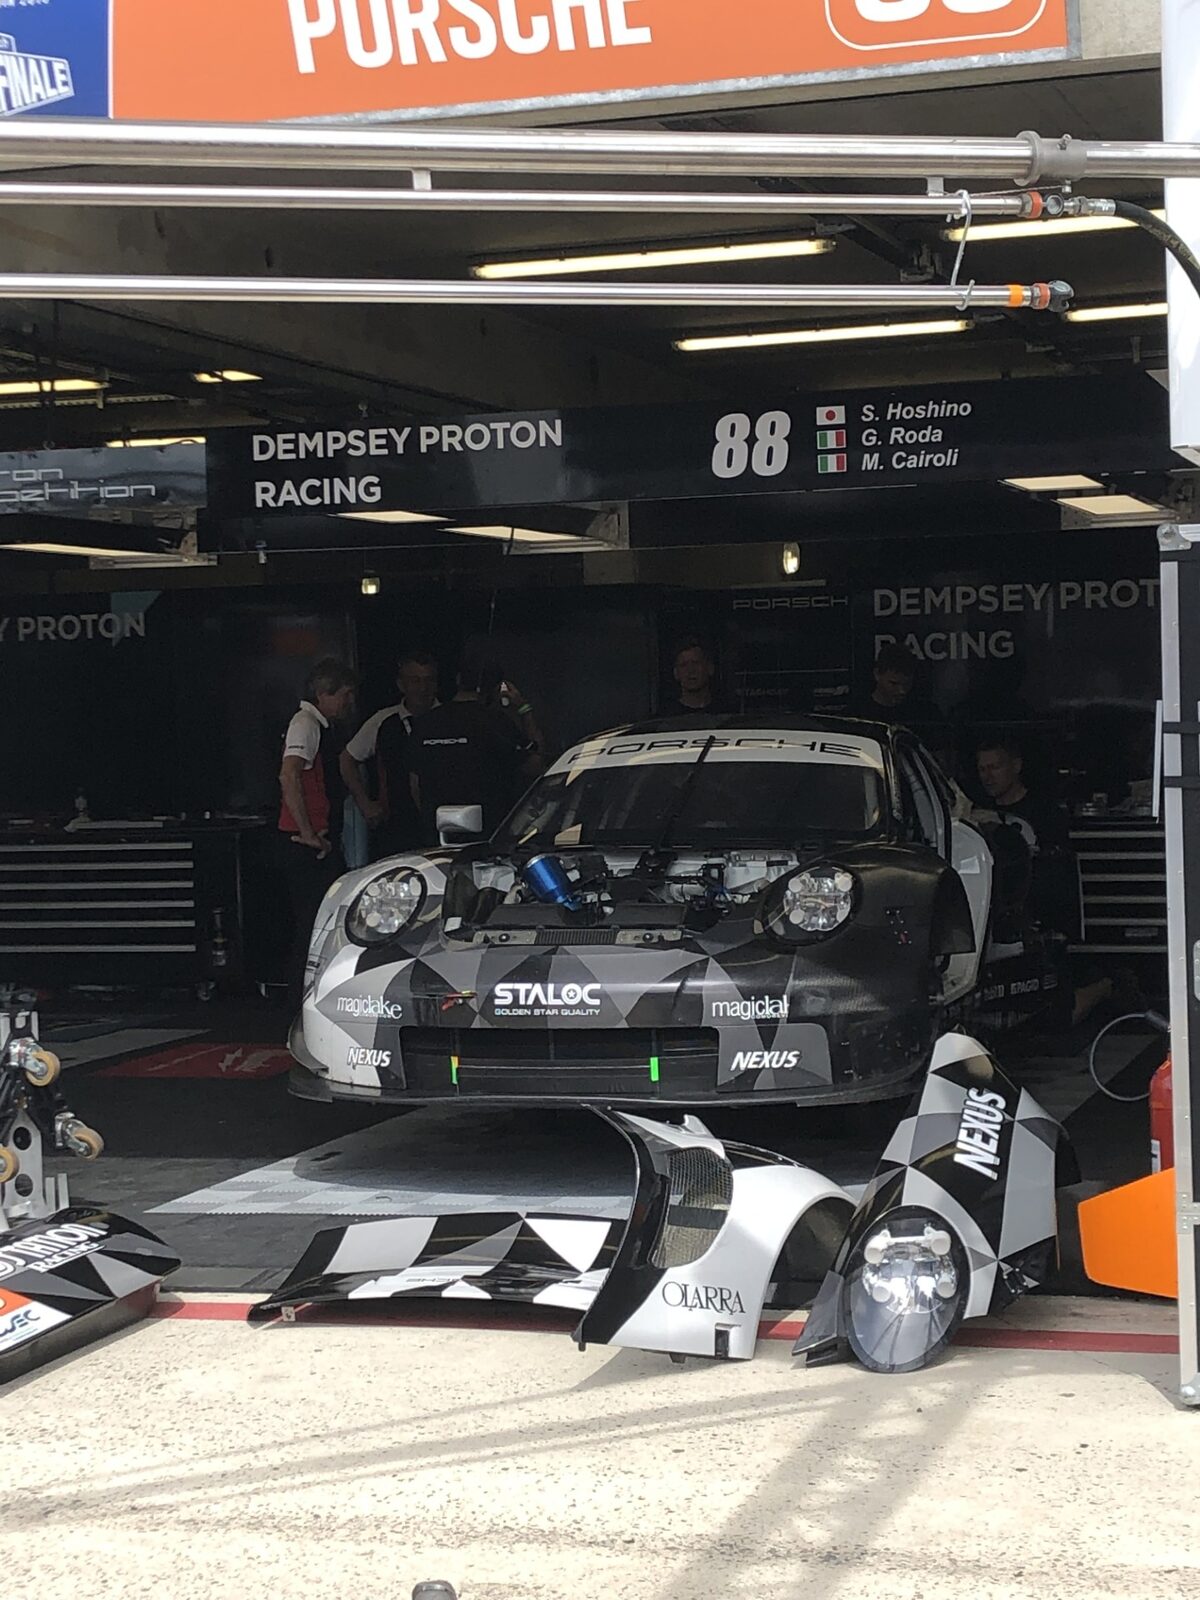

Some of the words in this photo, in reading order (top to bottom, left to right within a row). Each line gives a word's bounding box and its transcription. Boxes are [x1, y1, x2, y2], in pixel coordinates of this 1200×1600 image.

[861, 404, 880, 422] S.
[886, 400, 972, 421] Hoshino
[252, 427, 411, 461] DEMPSEY
[420, 419, 563, 453] PROTON
[711, 410, 792, 479] 88
[861, 428, 882, 446] G.
[889, 426, 943, 445] Roda
[861, 453, 884, 471] M.
[891, 449, 959, 470] Cairoli
[255, 475, 382, 508] RACING
[873, 583, 1051, 617] DEMPSEY
[17, 612, 146, 642] PROTON
[567, 738, 861, 764] PORSCHE
[336, 995, 402, 1019] magiclake
[494, 983, 601, 1005] STALOC
[494, 1008, 531, 1016] GOLDEN
[533, 1008, 558, 1016] STAR
[560, 1008, 600, 1016] QUALITY
[347, 1047, 392, 1067] NEXUS
[730, 1050, 800, 1071] NEXUS
[953, 1087, 1006, 1181] NEXUS
[26, 1241, 100, 1273] RACING
[662, 1281, 746, 1315] OLARRA
